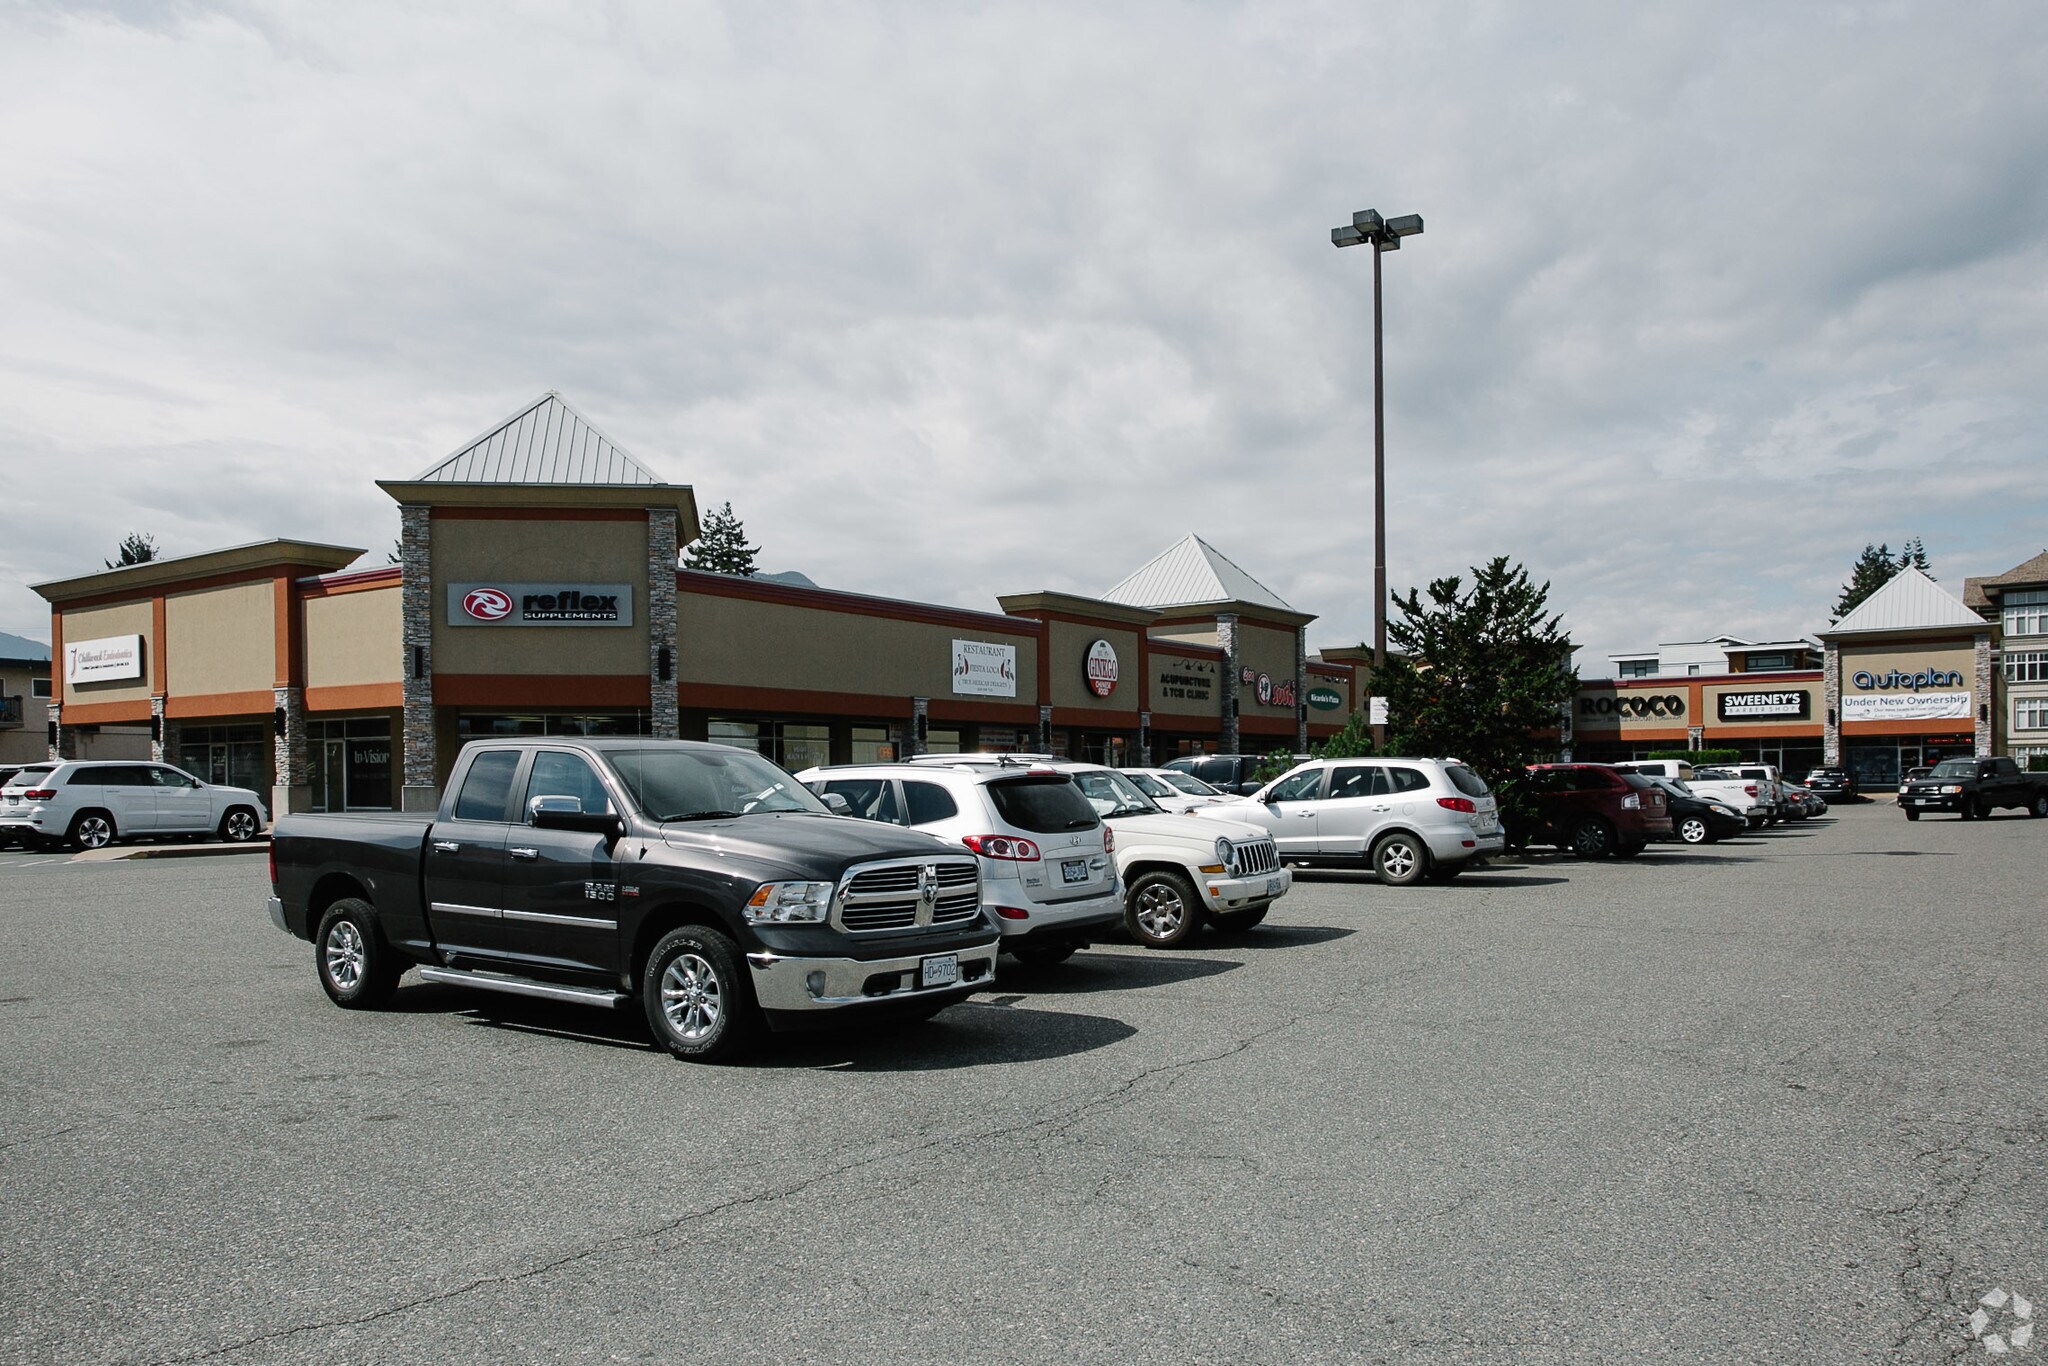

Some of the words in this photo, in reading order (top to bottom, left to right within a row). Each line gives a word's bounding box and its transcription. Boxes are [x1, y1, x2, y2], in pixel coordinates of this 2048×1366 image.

[522, 591, 618, 611] reflex
[523, 612, 617, 620] SUPPLEMENTS
[963, 644, 1006, 658] RESTAURANT
[1090, 657, 1117, 679] GINKGO
[1186, 689, 1210, 701] CLINIC
[1725, 693, 1801, 706] SWEENEY'S
[1844, 698, 1877, 707] Under
[1880, 697, 1905, 706] New
[1906, 694, 1969, 705] Ownership
[1579, 694, 1685, 717] ROCOCO
[584, 882, 616, 892] RAM
[584, 890, 615, 901] 1500
